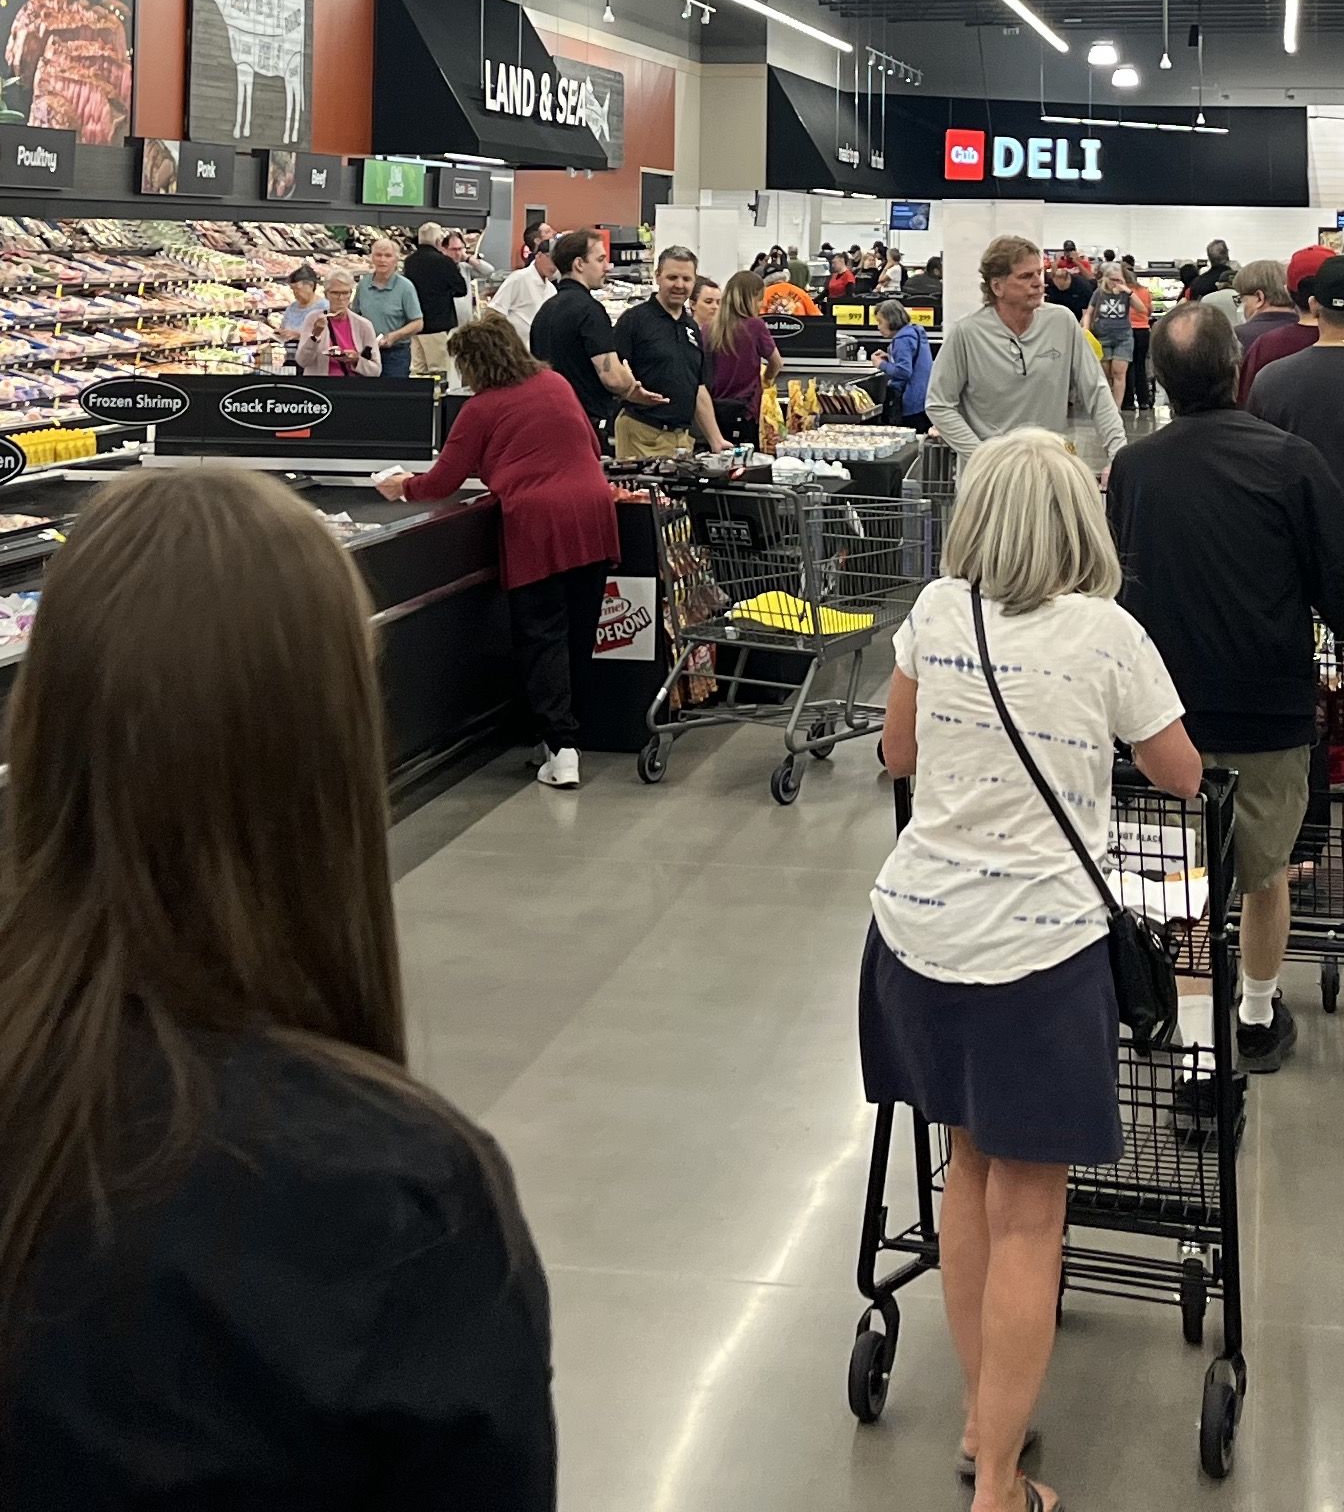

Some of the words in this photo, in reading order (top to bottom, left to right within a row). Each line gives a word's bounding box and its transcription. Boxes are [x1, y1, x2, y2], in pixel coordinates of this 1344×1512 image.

[485, 59, 536, 117] LAND
[539, 72, 554, 122] &
[556, 77, 587, 127] SEA
[17, 145, 57, 173] Poultry
[992, 136, 1103, 180] DELI
[88, 393, 133, 408] Frozen
[136, 394, 183, 412] Shrimp
[224, 398, 264, 413] Snack
[266, 400, 329, 415] Favorites
